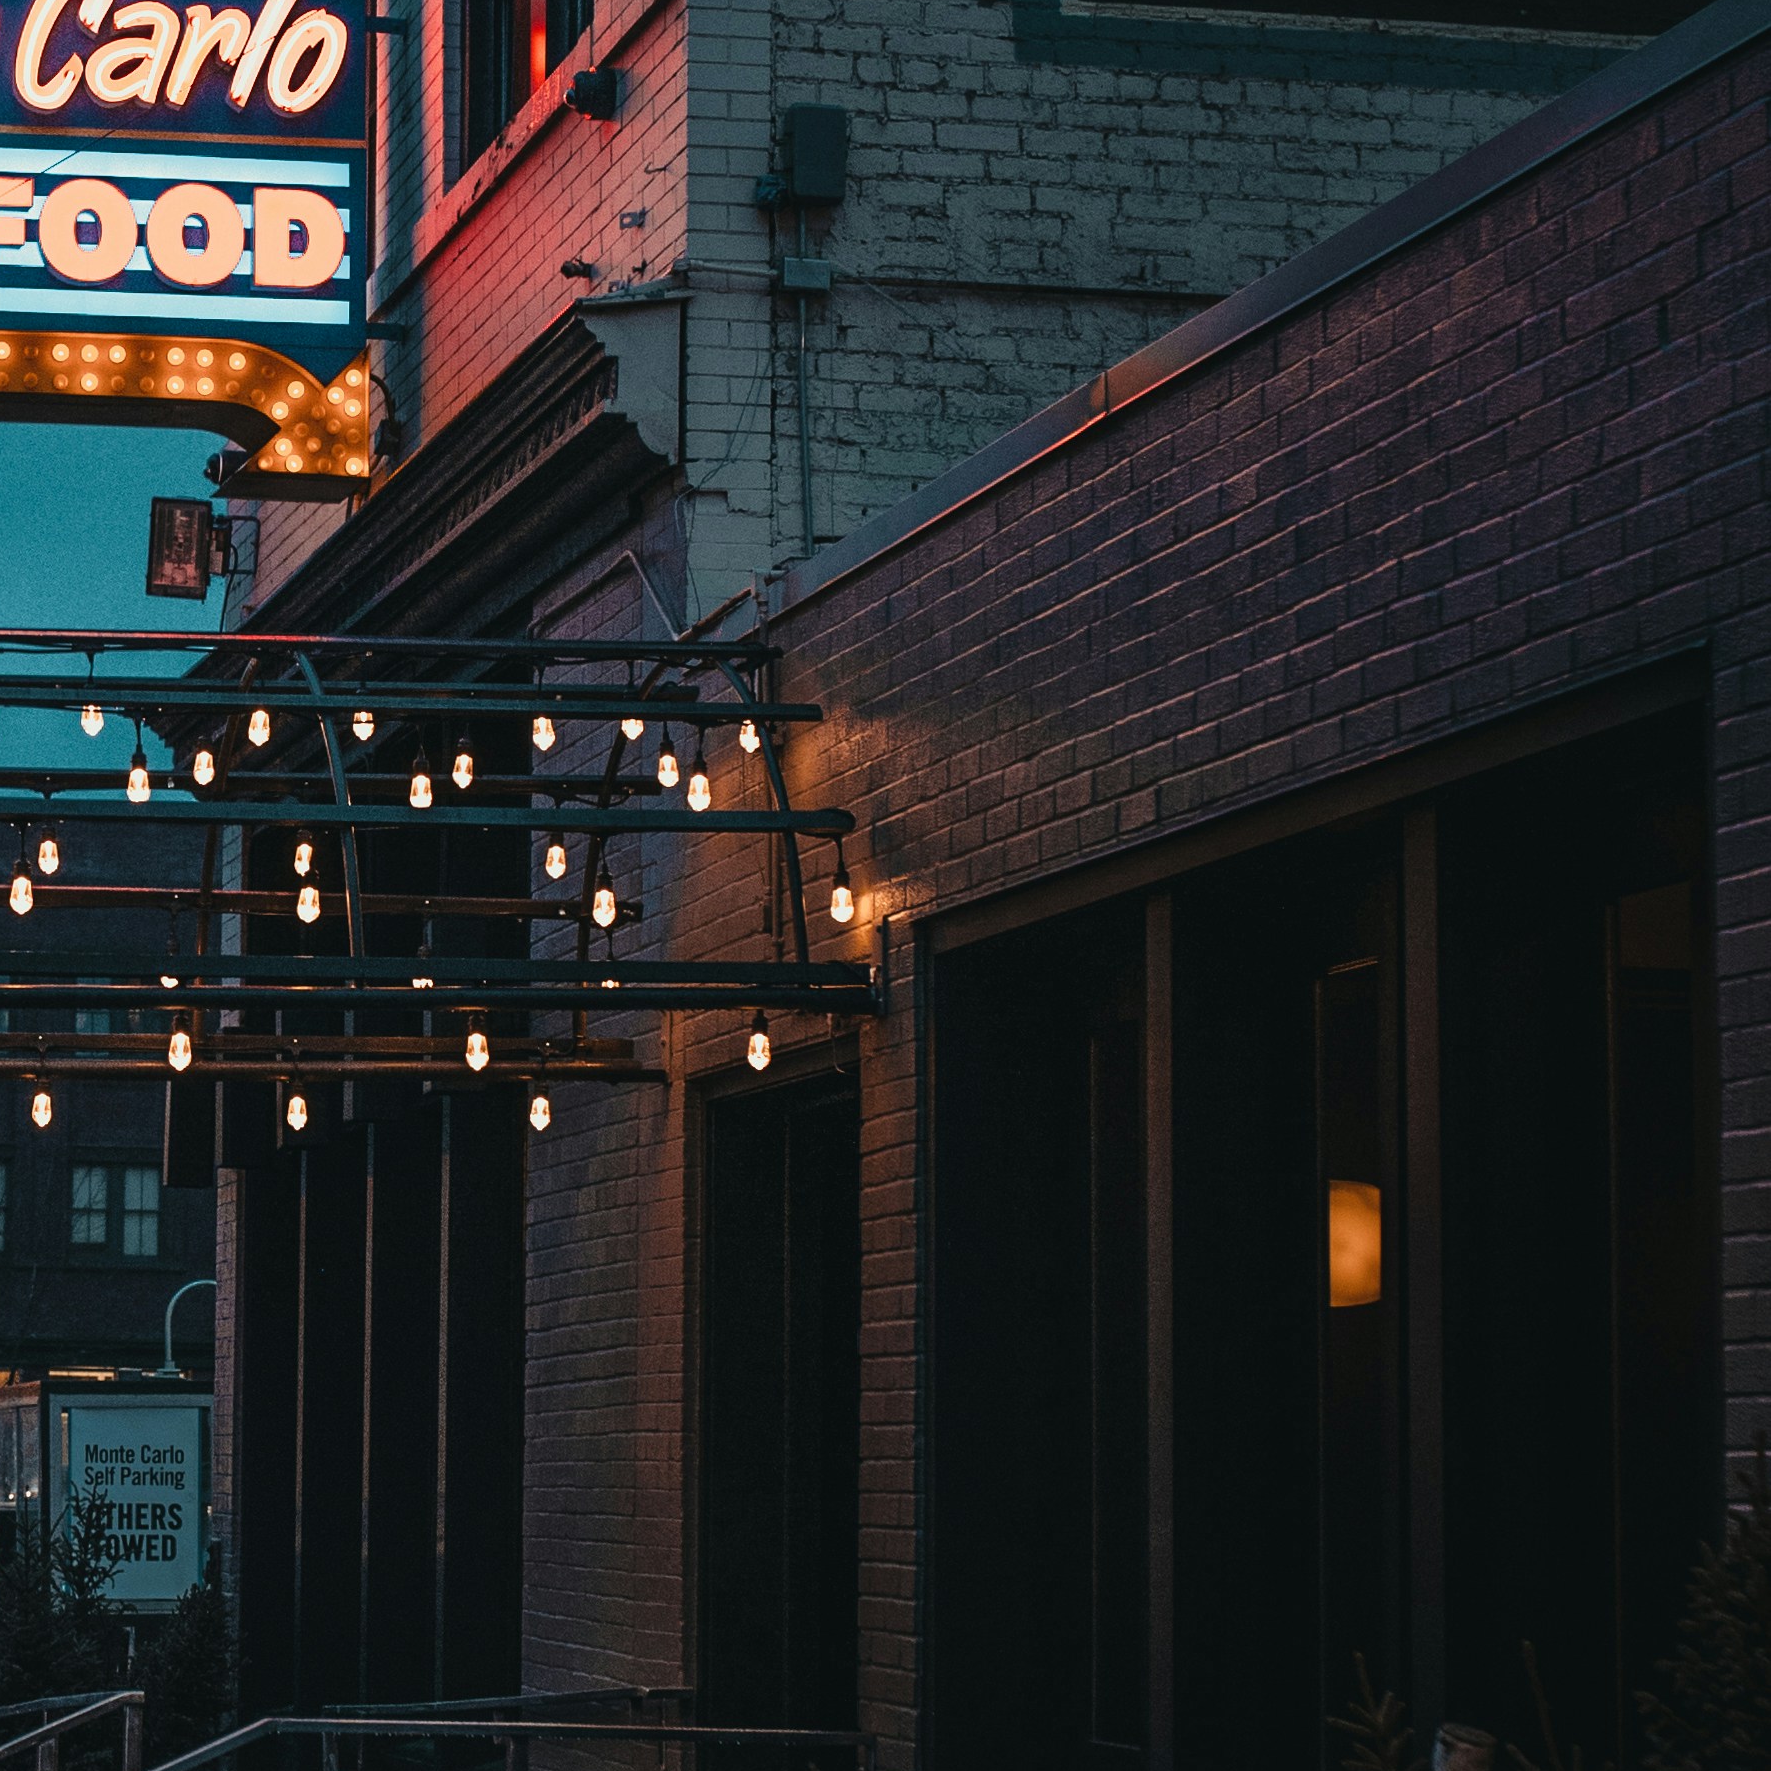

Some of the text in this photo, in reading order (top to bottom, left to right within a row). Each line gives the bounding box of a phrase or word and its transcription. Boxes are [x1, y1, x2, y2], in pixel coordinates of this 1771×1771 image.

[84, 1443, 185, 1464] Monte Carlo
[84, 1466, 186, 1491] Self Parking
